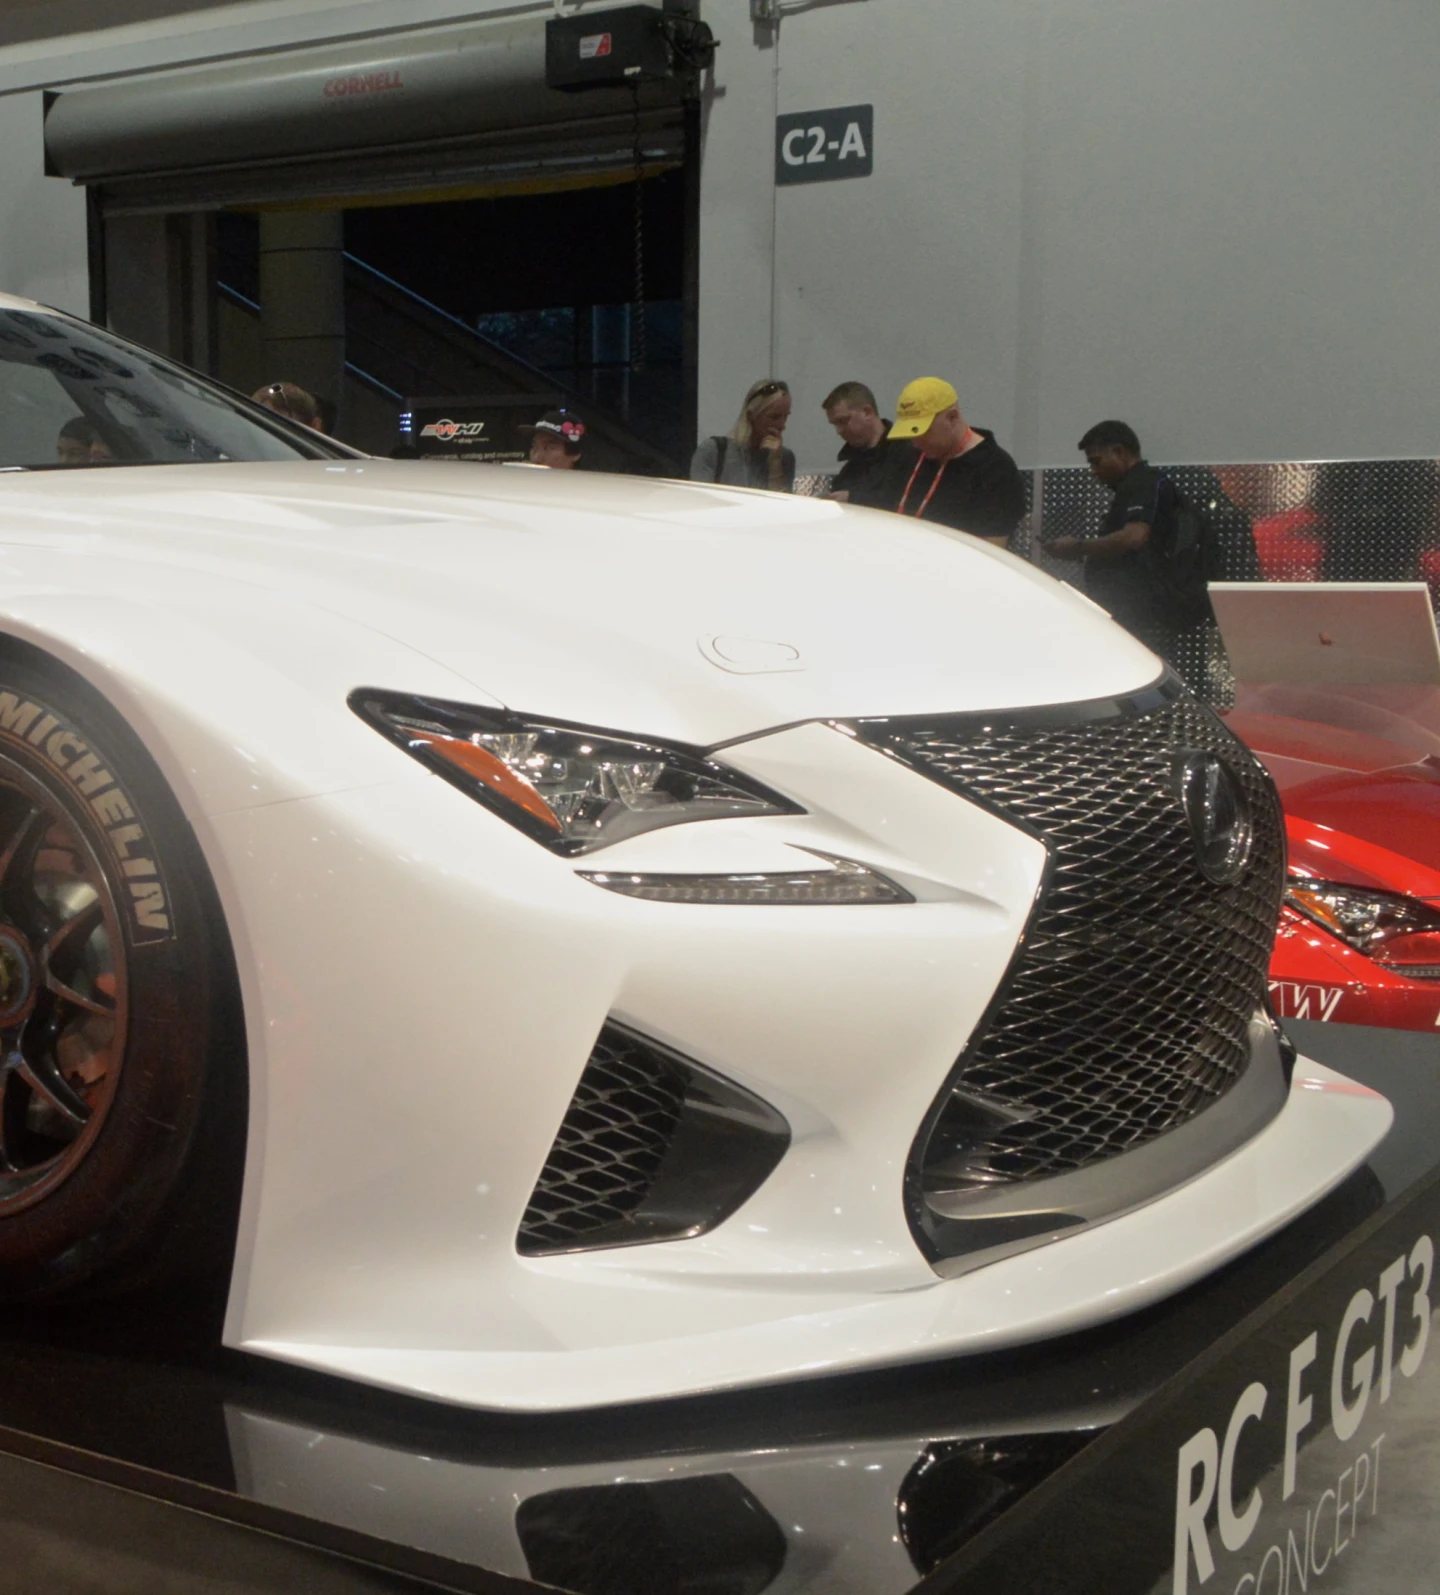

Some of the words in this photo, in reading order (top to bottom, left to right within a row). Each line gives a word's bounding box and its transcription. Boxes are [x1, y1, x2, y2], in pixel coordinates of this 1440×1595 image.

[781, 122, 867, 166] C2-A
[1172, 1381, 1268, 1595] RC
[1282, 1330, 1318, 1502] F
[1331, 1234, 1434, 1441] GT3
[1233, 1432, 1386, 1595] ONCEPT
